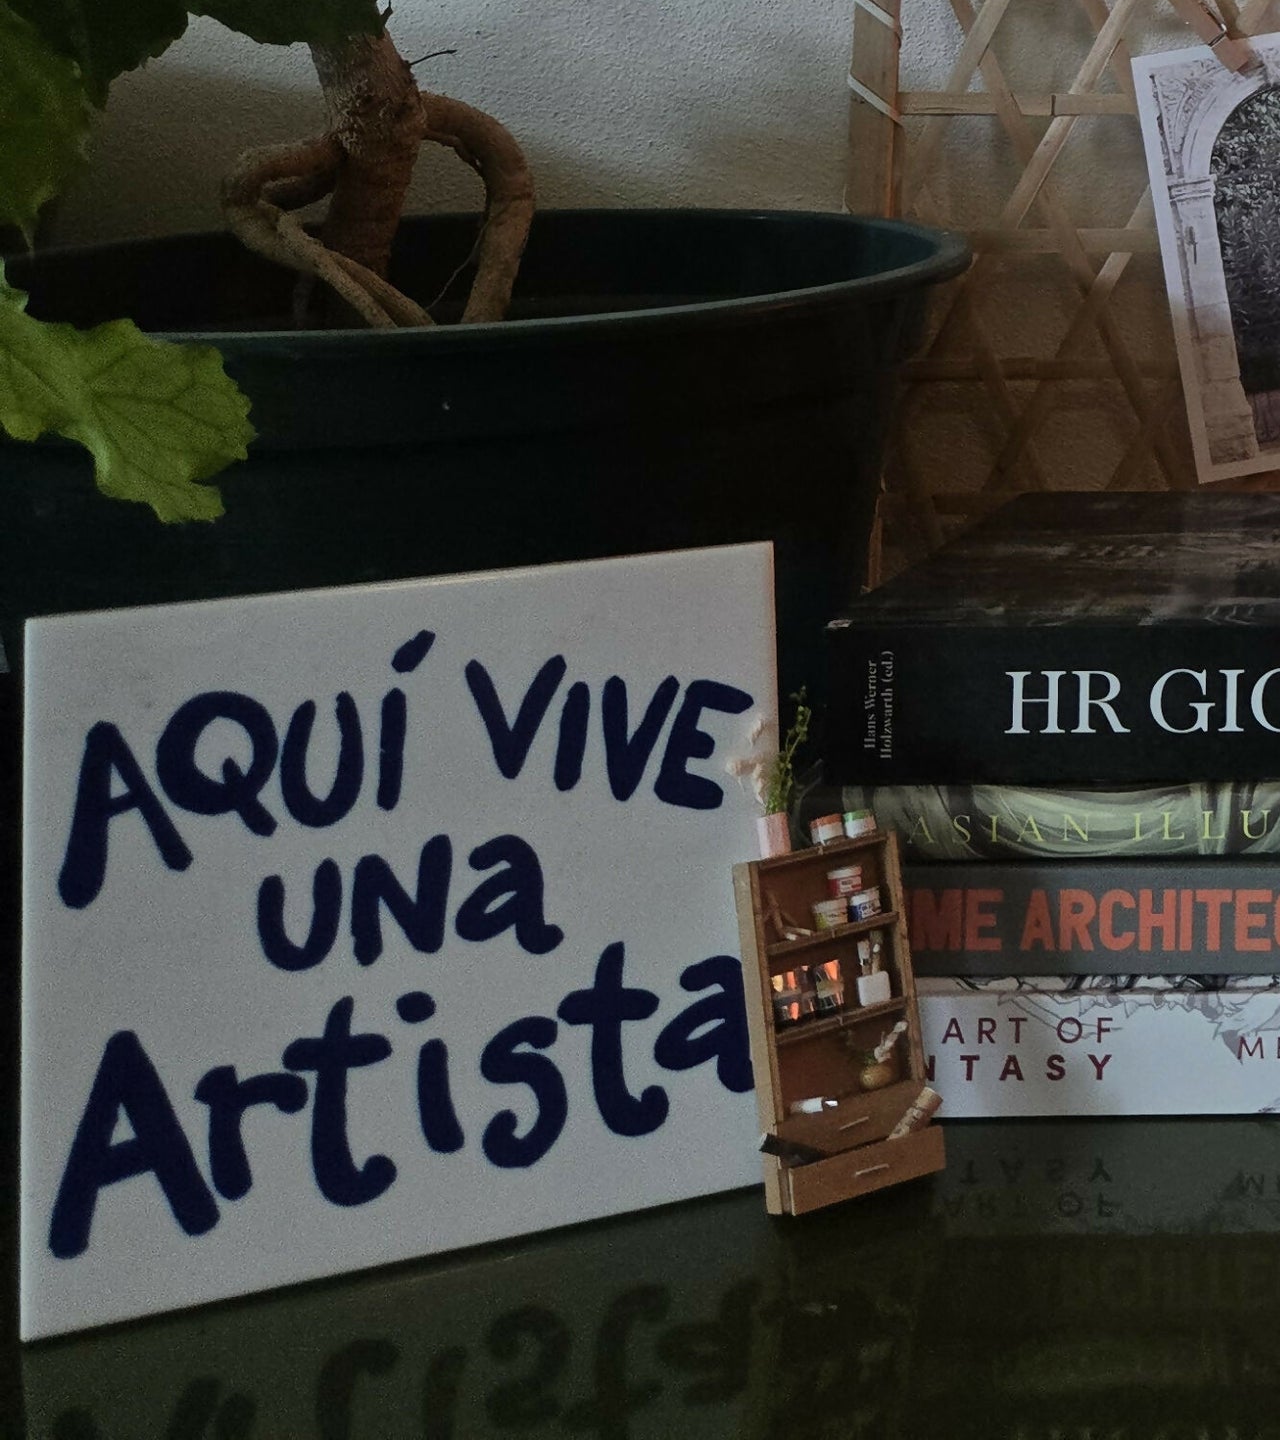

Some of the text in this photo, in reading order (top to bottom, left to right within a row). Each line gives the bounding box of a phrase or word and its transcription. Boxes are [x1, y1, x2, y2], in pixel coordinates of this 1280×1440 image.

[465, 654, 753, 810] VIVE
[864, 660, 877, 748] Hans Werner
[880, 688, 893, 758] Holzwarth
[1004, 670, 1131, 734] HR
[907, 813, 1090, 845] ASIAN
[941, 1016, 1113, 1044] ART OF
[47, 941, 753, 1259] Artista
